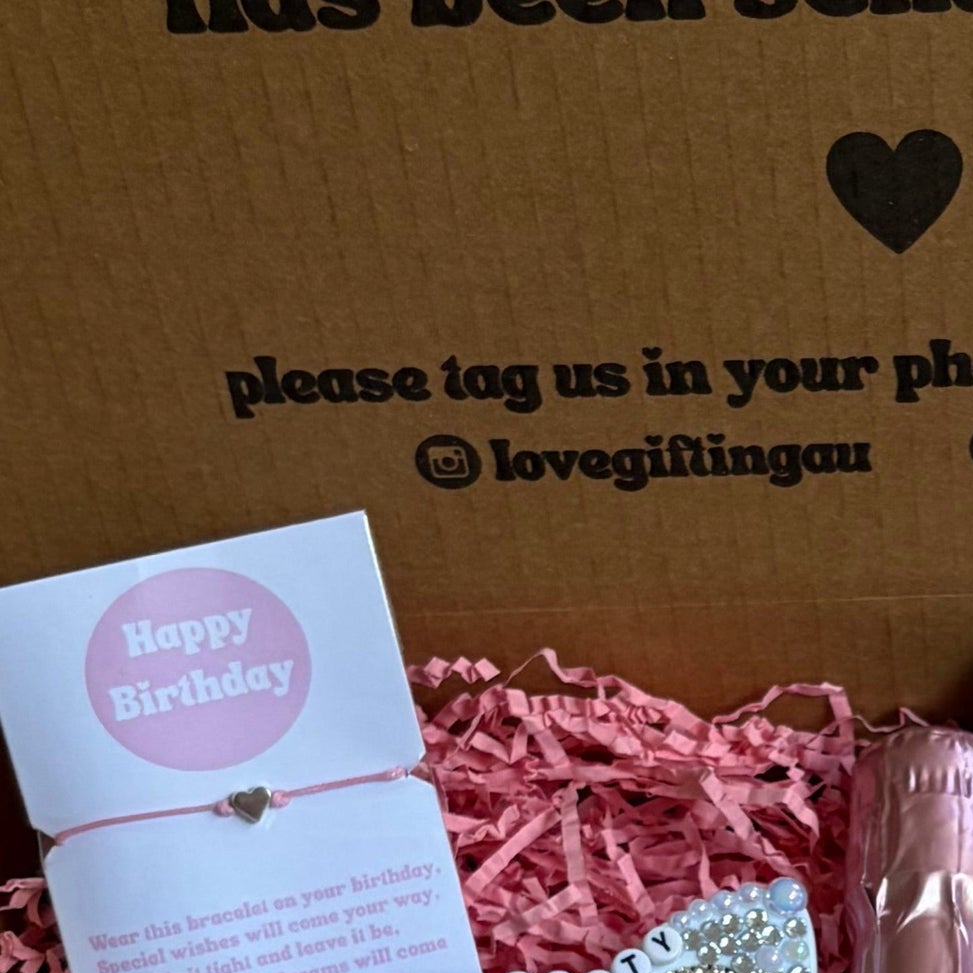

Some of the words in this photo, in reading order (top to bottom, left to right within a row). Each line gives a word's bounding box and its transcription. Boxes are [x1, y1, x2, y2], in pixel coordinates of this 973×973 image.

[225, 356, 431, 419] please
[441, 354, 543, 414] tag
[553, 361, 631, 399] us
[641, 347, 712, 397] in
[723, 354, 878, 408] your
[487, 434, 872, 491] lovegiftingau
[121, 608, 252, 658] Happy
[108, 659, 294, 721] Birthday
[88, 931, 140, 951] Wear
[144, 921, 182, 940] this
[186, 900, 268, 931] bracelet
[273, 895, 297, 911] on
[301, 883, 346, 908] your
[170, 934, 240, 960] wishes
[245, 920, 284, 942] will
[288, 912, 339, 932] come
[343, 900, 388, 924] your
[256, 944, 293, 966] and
[295, 935, 347, 957] leave
[351, 928, 365, 945] it
[354, 947, 393, 969] will
[396, 937, 448, 960] come
